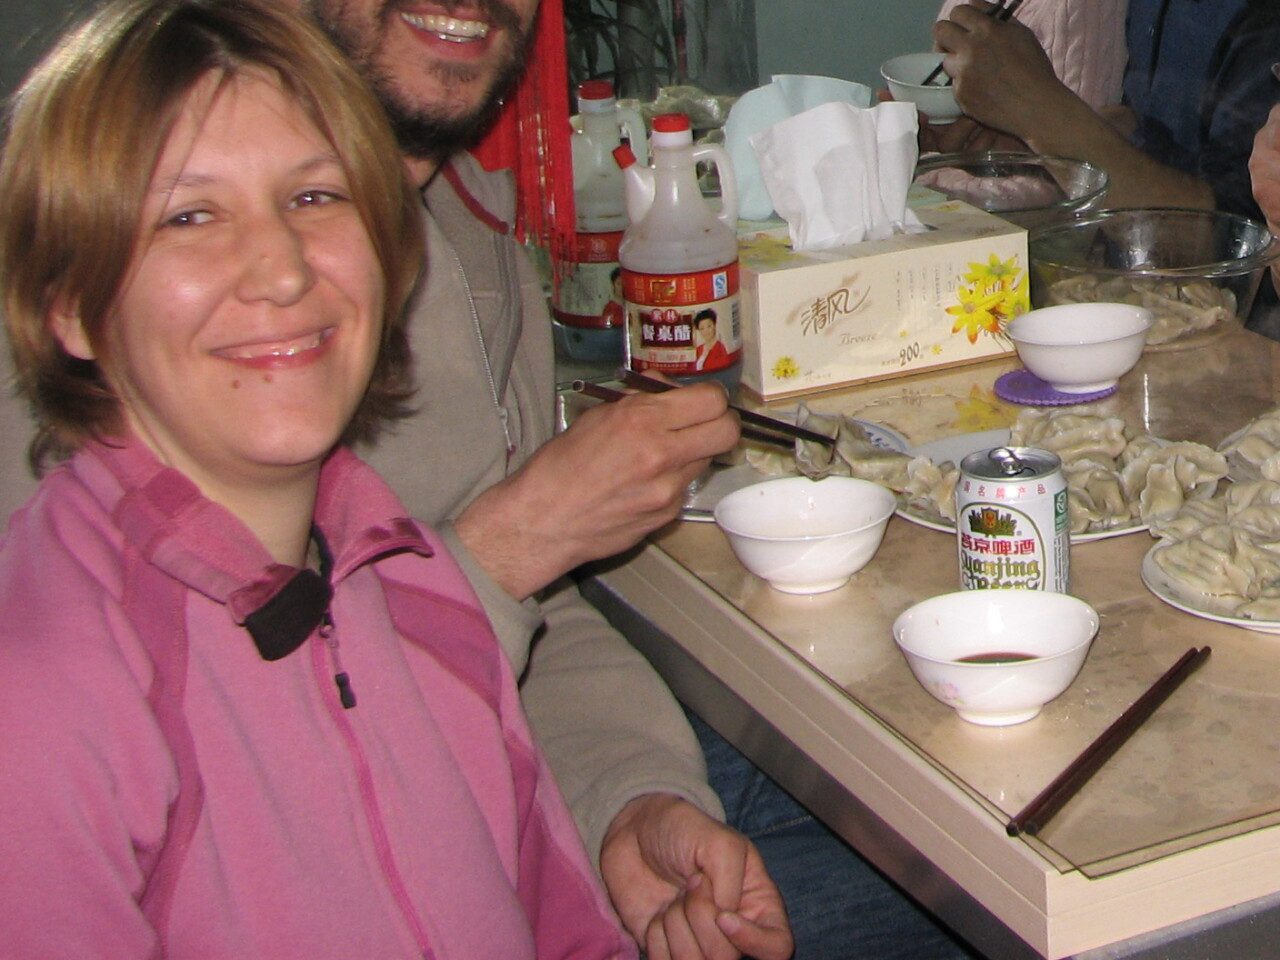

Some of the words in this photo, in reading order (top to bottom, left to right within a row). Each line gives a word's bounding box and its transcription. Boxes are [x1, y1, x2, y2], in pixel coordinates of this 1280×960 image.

[800, 285, 871, 336] 清风
[900, 341, 920, 367] 200
[961, 532, 1036, 556] 燕京啤酒
